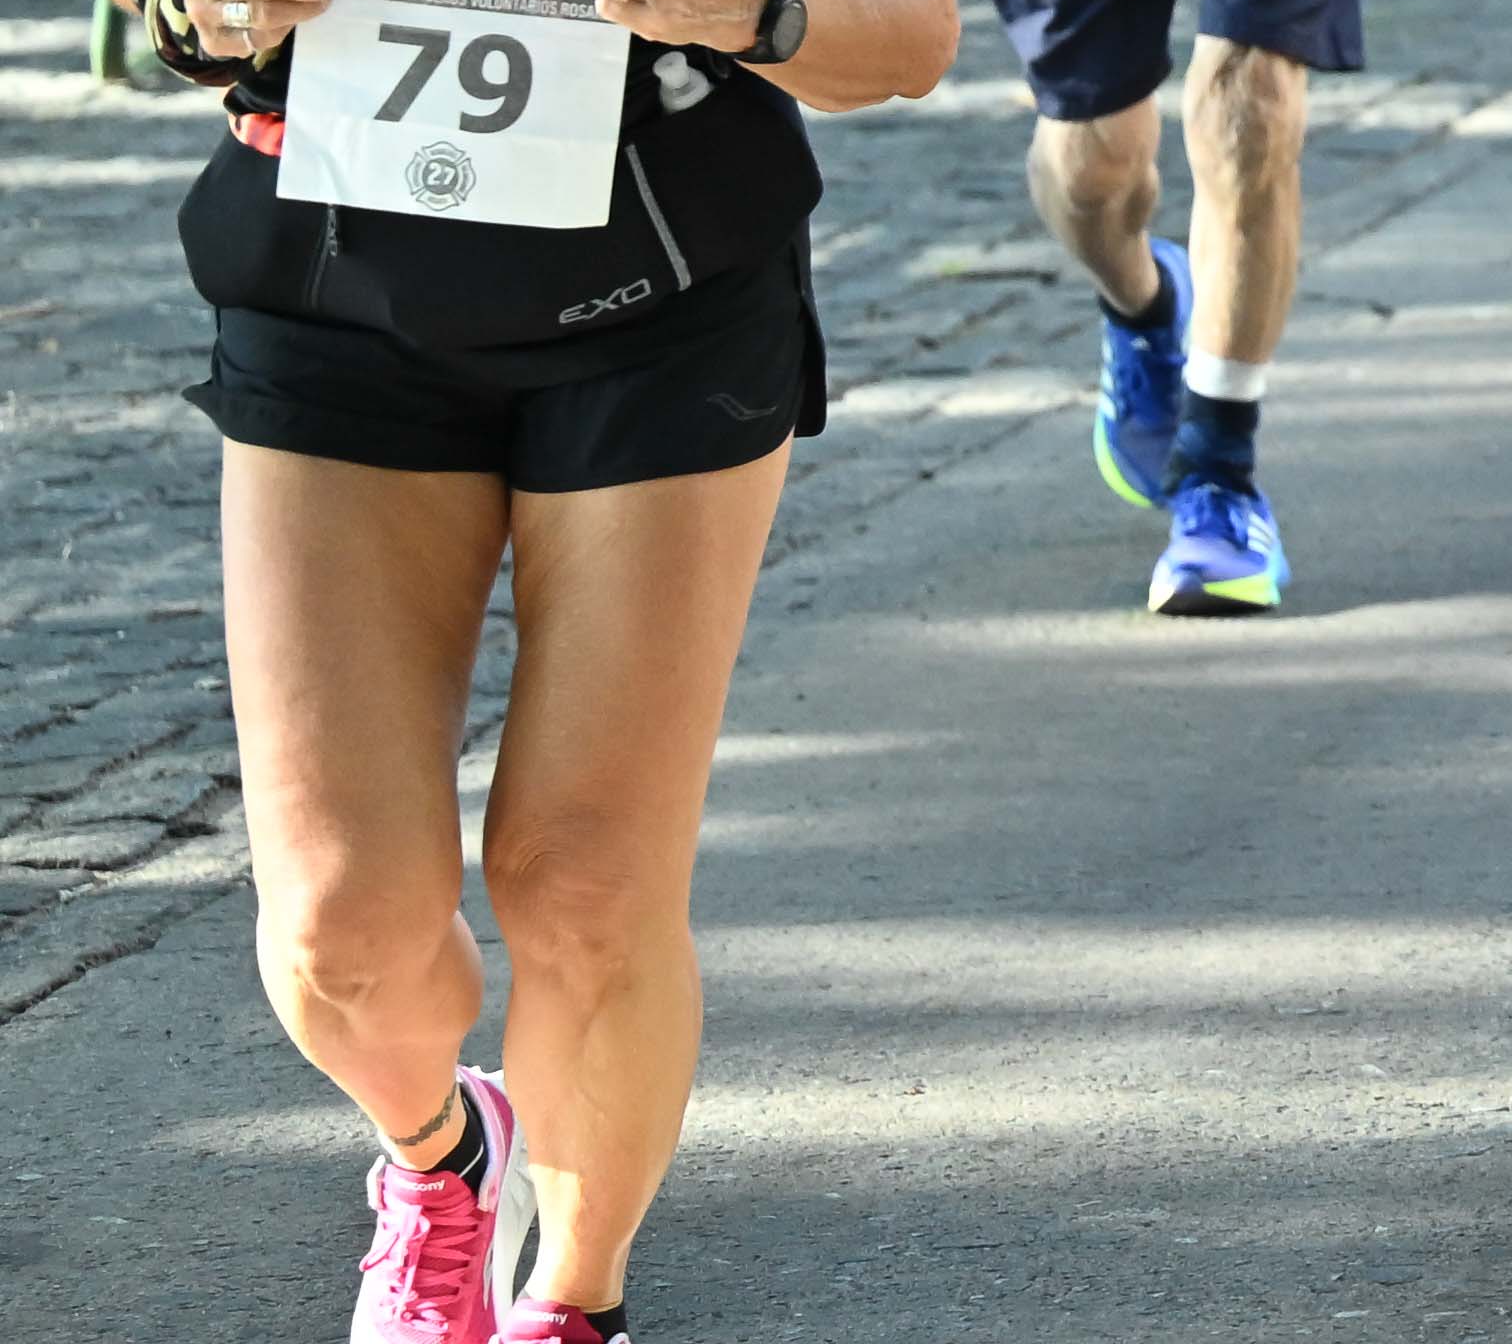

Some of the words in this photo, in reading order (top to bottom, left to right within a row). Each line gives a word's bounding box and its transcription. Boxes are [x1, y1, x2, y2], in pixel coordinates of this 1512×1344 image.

[560, 1, 598, 19] ROSA
[374, 22, 533, 134] 79
[559, 278, 651, 324] EXO
